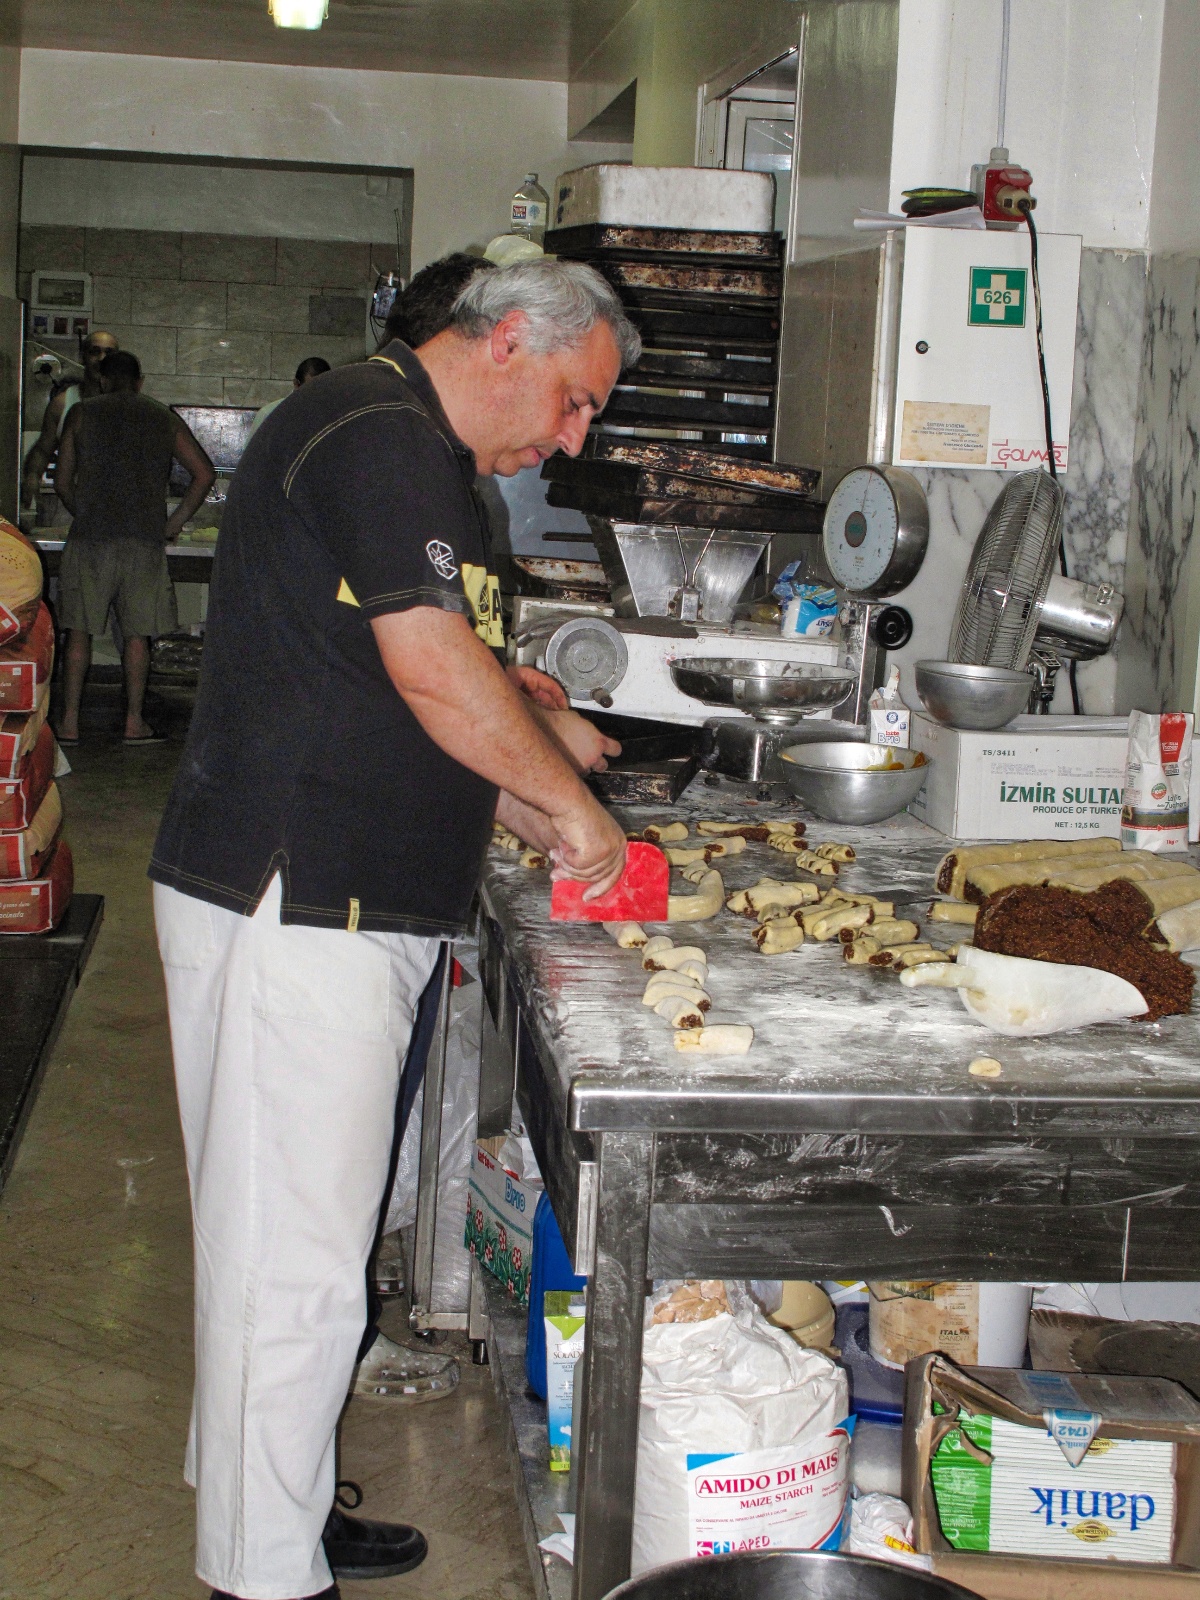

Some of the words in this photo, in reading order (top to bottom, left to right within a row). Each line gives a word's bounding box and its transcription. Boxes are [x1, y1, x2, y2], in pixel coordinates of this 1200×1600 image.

[984, 290, 1012, 304] 626
[1000, 781, 1056, 804] İZMİR
[1032, 806, 1074, 814] PRODUCE
[1076, 806, 1088, 814] OF
[1090, 806, 1122, 815] TURKEY
[1058, 1426, 1088, 1436] 1742
[698, 1475, 770, 1494] AMIDO
[776, 1468, 796, 1485] DI
[802, 1452, 838, 1478] MAIS
[740, 1494, 772, 1510] MAIZE
[774, 1484, 814, 1502] STARCH
[1028, 1487, 1155, 1531] danik
